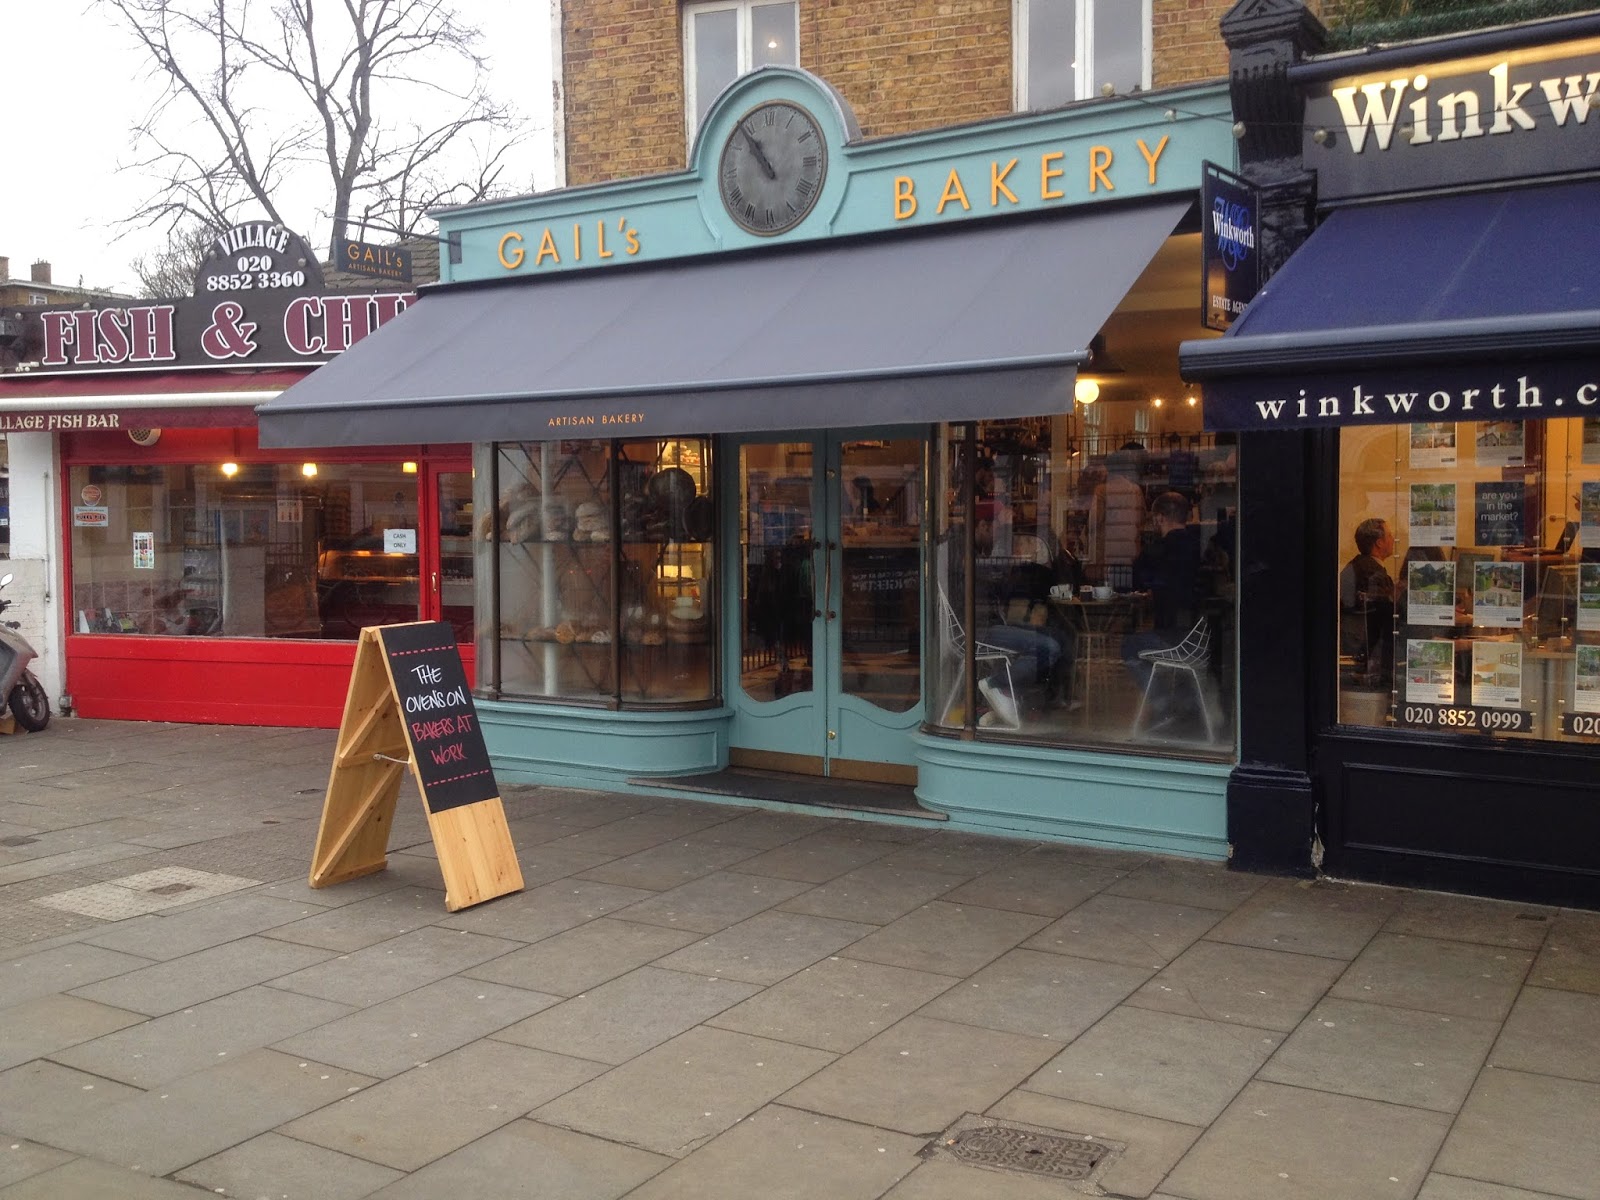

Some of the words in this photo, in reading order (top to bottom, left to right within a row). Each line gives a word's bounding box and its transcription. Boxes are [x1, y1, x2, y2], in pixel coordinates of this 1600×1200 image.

[498, 216, 641, 269] GAIL's
[893, 134, 1169, 220] BAKERY
[1212, 210, 1255, 249] Winkworth
[217, 224, 291, 257] VILLAGE
[237, 255, 272, 272] 020
[348, 263, 375, 273] ARTISAN
[206, 274, 253, 292] 8852
[258, 270, 305, 288] 3360
[1212, 295, 1231, 312] ESTATE
[41, 305, 176, 366] FISH
[201, 301, 258, 359] &
[48, 414, 83, 431] FISH
[87, 413, 120, 428] BAR
[548, 416, 595, 427] ARTISAN
[602, 413, 645, 424] BAKERY
[1482, 492, 1497, 500] are
[1499, 492, 1517, 501] you
[1486, 502, 1495, 510] in
[1497, 501, 1512, 510] the
[1480, 512, 1518, 521] market?
[410, 664, 443, 685] THE
[446, 685, 467, 707] ON
[411, 717, 456, 742] BAKERS
[456, 714, 473, 733] AT
[1405, 706, 1433, 724] 020
[1437, 709, 1476, 728] 8852
[1481, 711, 1522, 730] 0999
[430, 742, 468, 765] WORK
